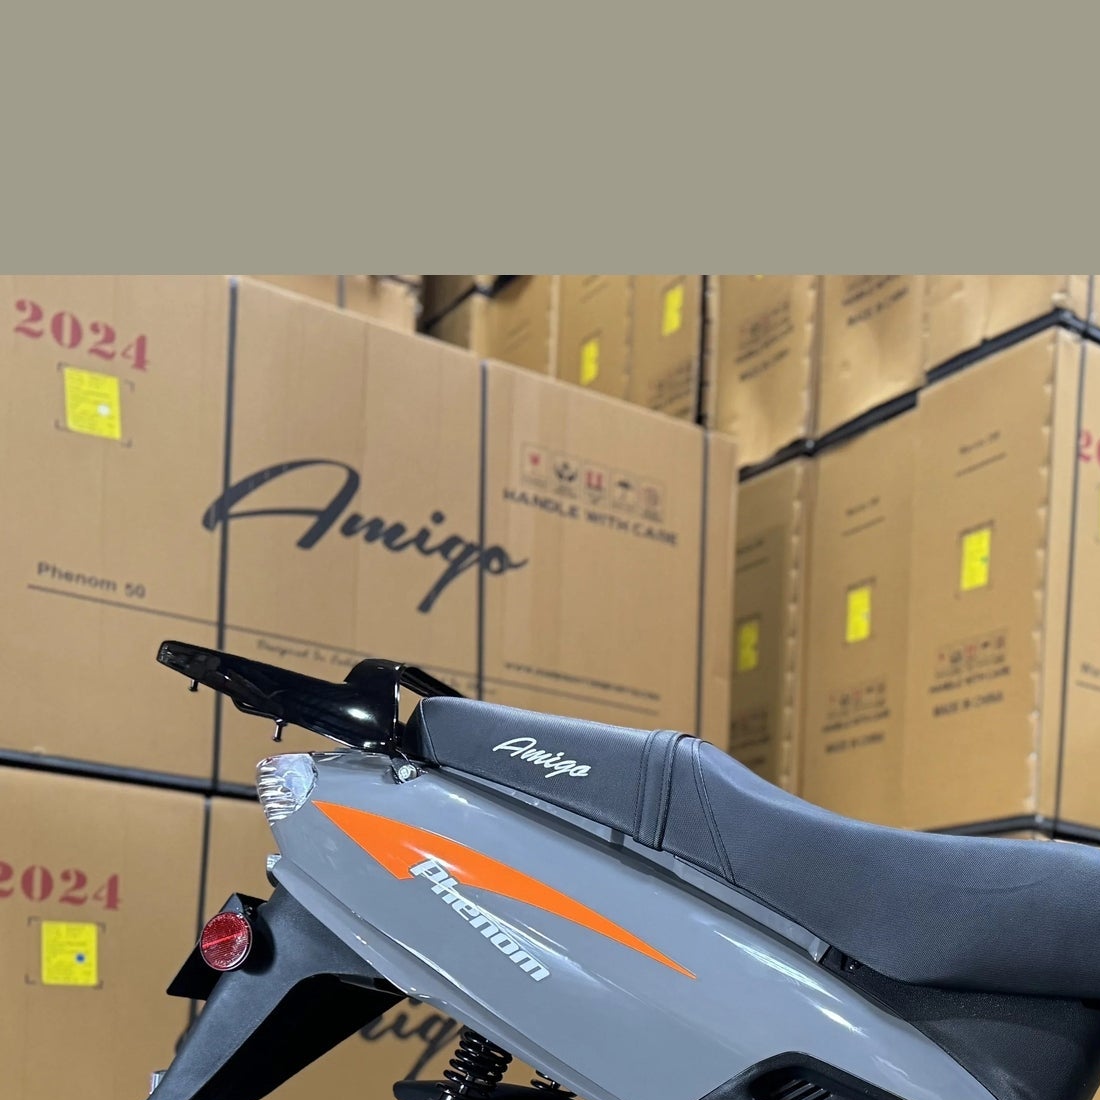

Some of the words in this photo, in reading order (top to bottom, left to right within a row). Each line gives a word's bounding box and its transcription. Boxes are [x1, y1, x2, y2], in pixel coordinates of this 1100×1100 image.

[14, 299, 149, 372] 2024
[202, 457, 529, 614] Amigo
[37, 560, 117, 593] Phenom
[124, 581, 146, 599] 50
[492, 737, 592, 779] Amigo
[409, 858, 551, 981] Phenom
